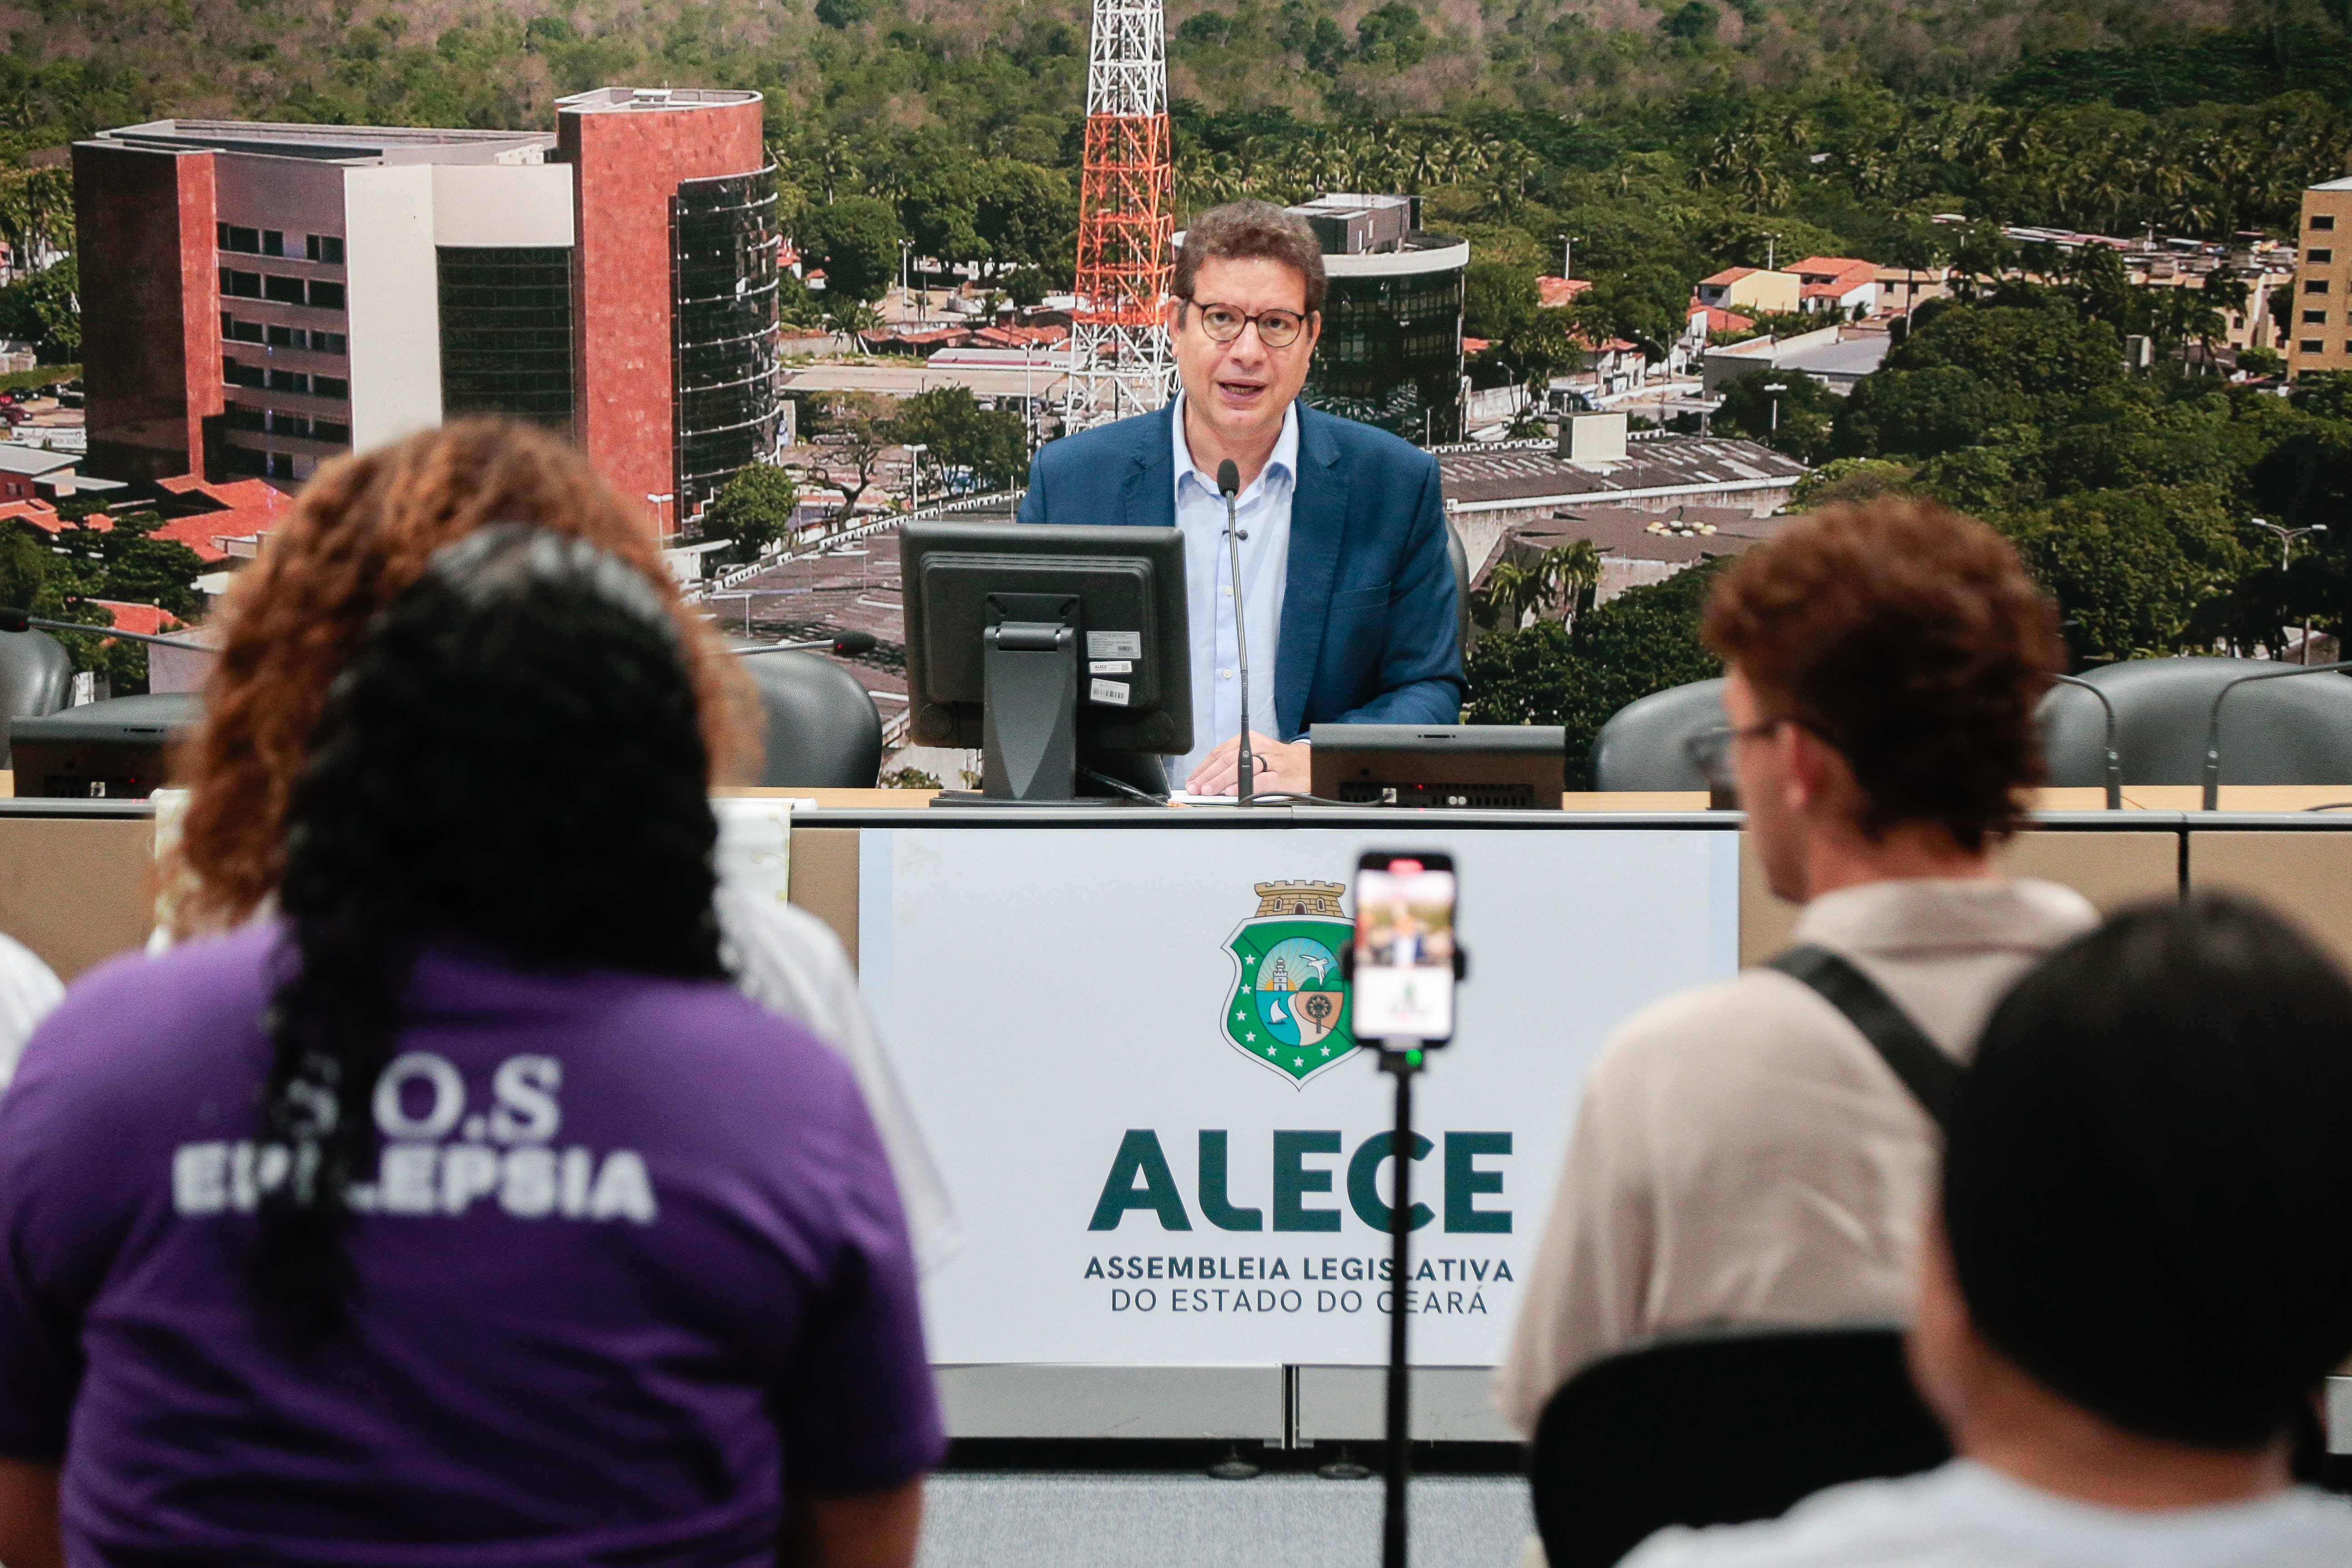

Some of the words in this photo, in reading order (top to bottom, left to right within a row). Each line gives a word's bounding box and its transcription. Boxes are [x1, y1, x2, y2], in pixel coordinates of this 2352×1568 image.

[1087, 1129, 1512, 1233] ALECE
[1084, 1256, 1290, 1280] ASSEMBLEIA
[1304, 1257, 1513, 1281] LEGISATIVA
[1112, 1289, 1156, 1312] DO
[1171, 1289, 1302, 1312] ESTADO
[1318, 1290, 1362, 1313] DO
